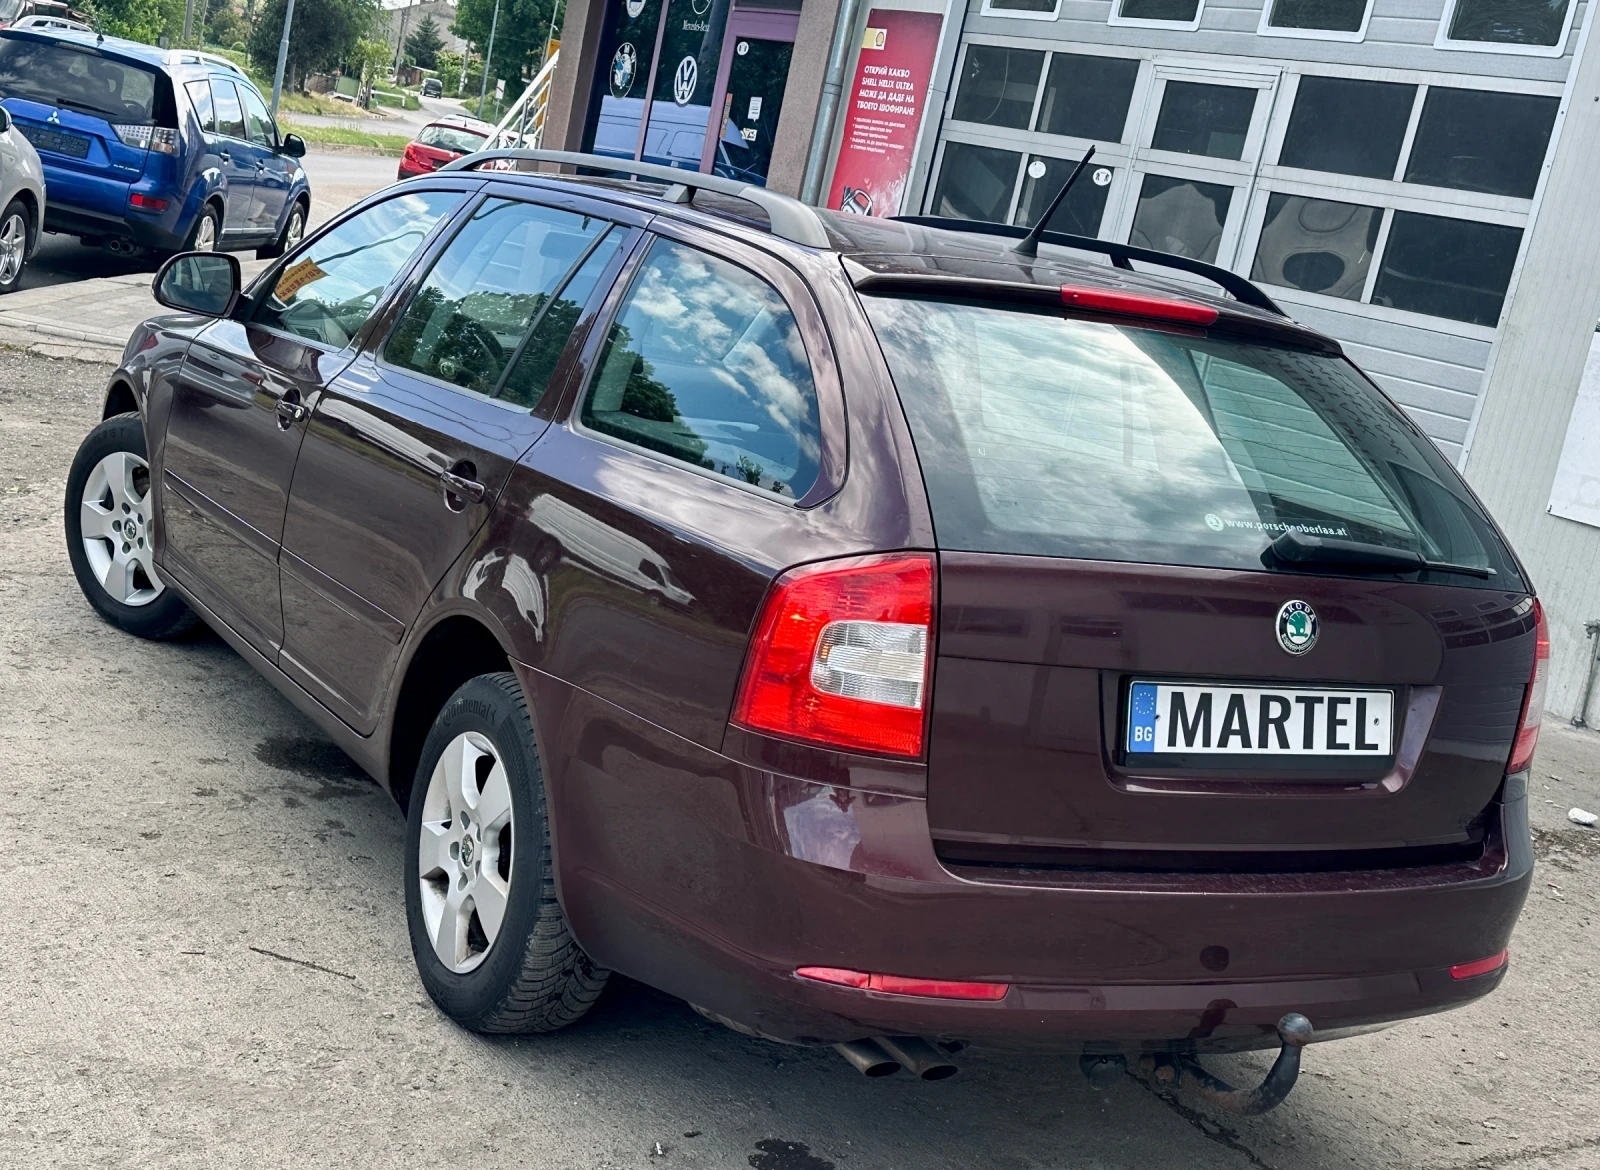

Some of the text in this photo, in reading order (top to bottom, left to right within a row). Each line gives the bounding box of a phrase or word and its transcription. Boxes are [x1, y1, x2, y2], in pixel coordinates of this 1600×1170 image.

[864, 65, 910, 78] ОТКРИЙ КАКВО
[861, 77, 914, 91] SHELL HELIX ULTRA
[858, 89, 915, 104] МОЖЕ ДА ДАДЕ НА
[857, 100, 915, 116] ТВОЕТО ШОФИРАНЕ
[1134, 691, 1379, 751] BG MARTEL
